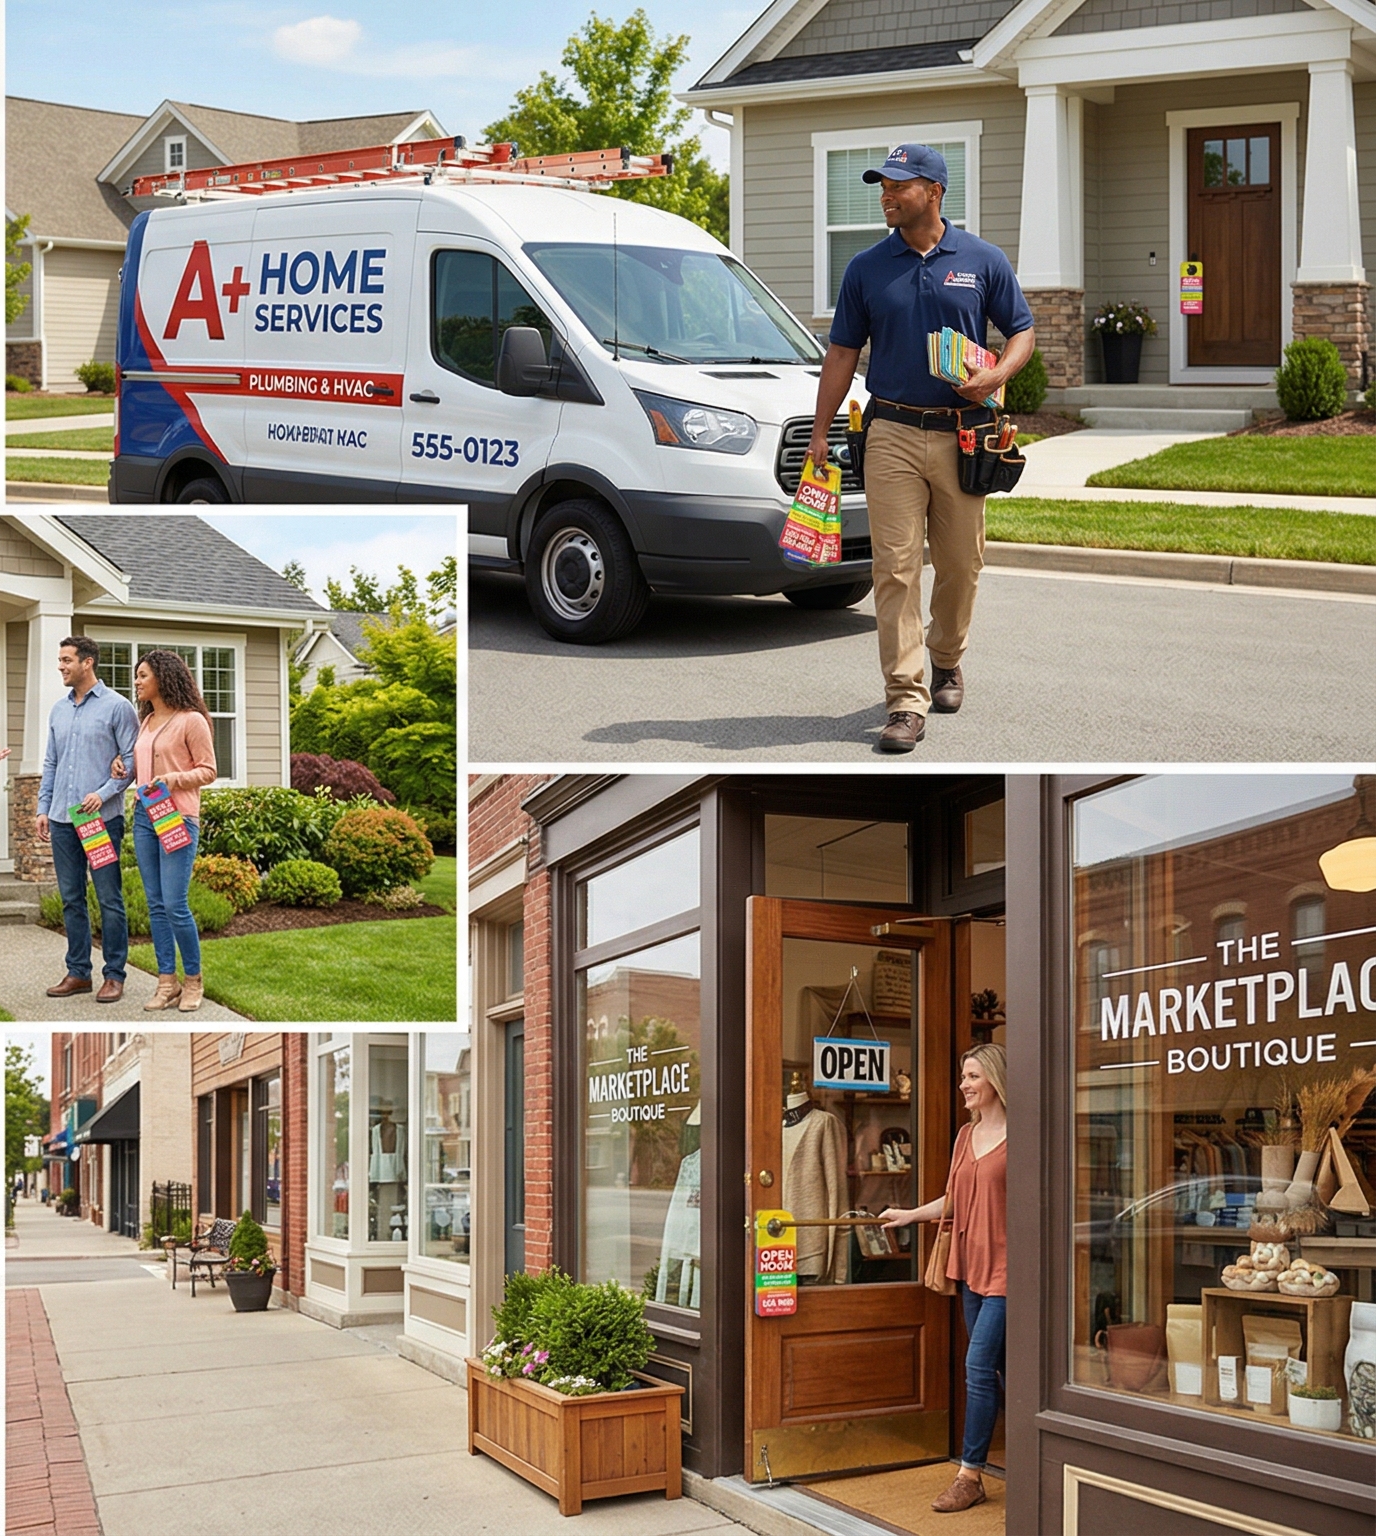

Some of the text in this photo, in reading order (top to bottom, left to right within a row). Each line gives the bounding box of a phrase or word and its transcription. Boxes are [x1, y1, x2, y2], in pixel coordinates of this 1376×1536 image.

[259, 249, 387, 295] HOME
[162, 240, 251, 341] A+
[254, 303, 384, 333] SERVICES
[249, 374, 375, 397] PLUMBING & HVAC
[411, 432, 520, 468] 555-0123
[1216, 932, 1280, 966] THE
[626, 1045, 648, 1063] THE
[821, 1046, 884, 1081] OPEN
[1167, 1033, 1337, 1074] BOUTIQUE
[589, 1062, 690, 1103] MARKETPLACE
[611, 1103, 665, 1123] BOUTIQUE
[761, 1250, 794, 1262] OPEN
